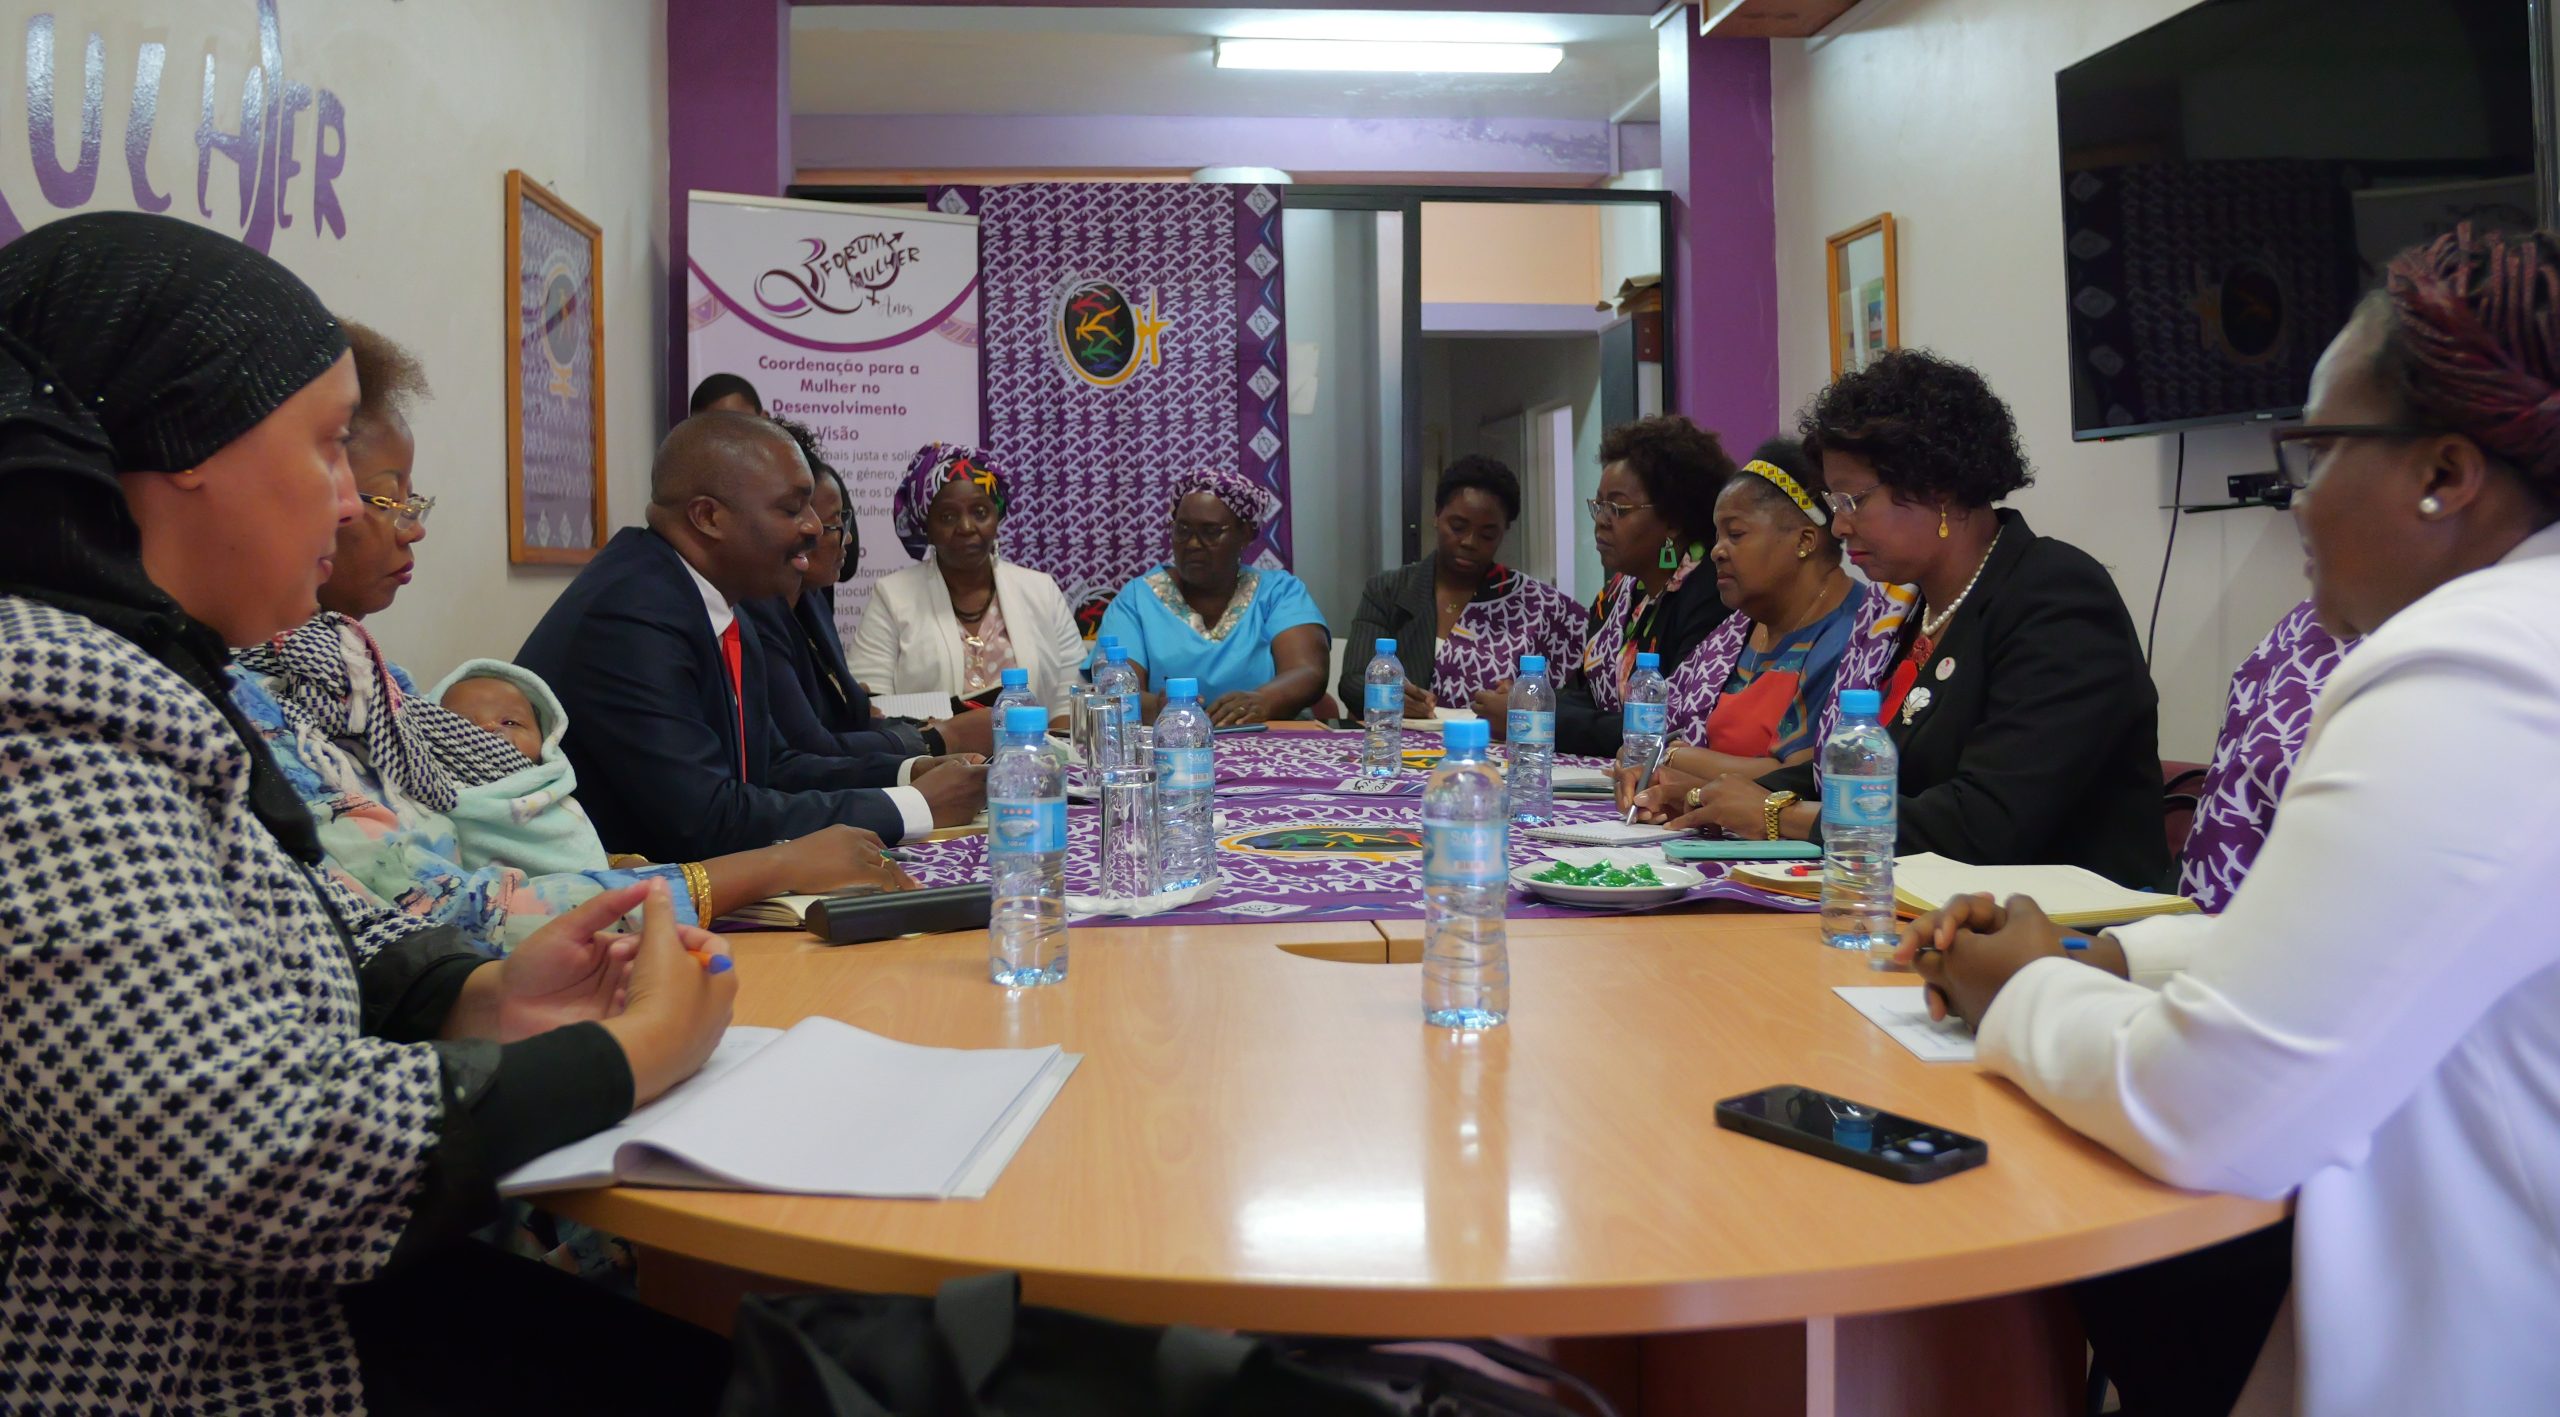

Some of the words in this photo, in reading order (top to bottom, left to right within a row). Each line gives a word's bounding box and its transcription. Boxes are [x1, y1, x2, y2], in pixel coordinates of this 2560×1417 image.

[820, 231, 886, 276] FORUM
[850, 247, 920, 291] MULHER
[758, 355, 864, 377] Coordenação
[868, 362, 904, 377] para
[909, 364, 920, 375] a
[800, 378, 857, 394] Mulher
[861, 382, 881, 394] no
[772, 398, 907, 417] Desenvolvimento
[816, 425, 860, 441] Visão
[852, 449, 879, 463] justa
[882, 452, 889, 461] e
[869, 489, 881, 498] os
